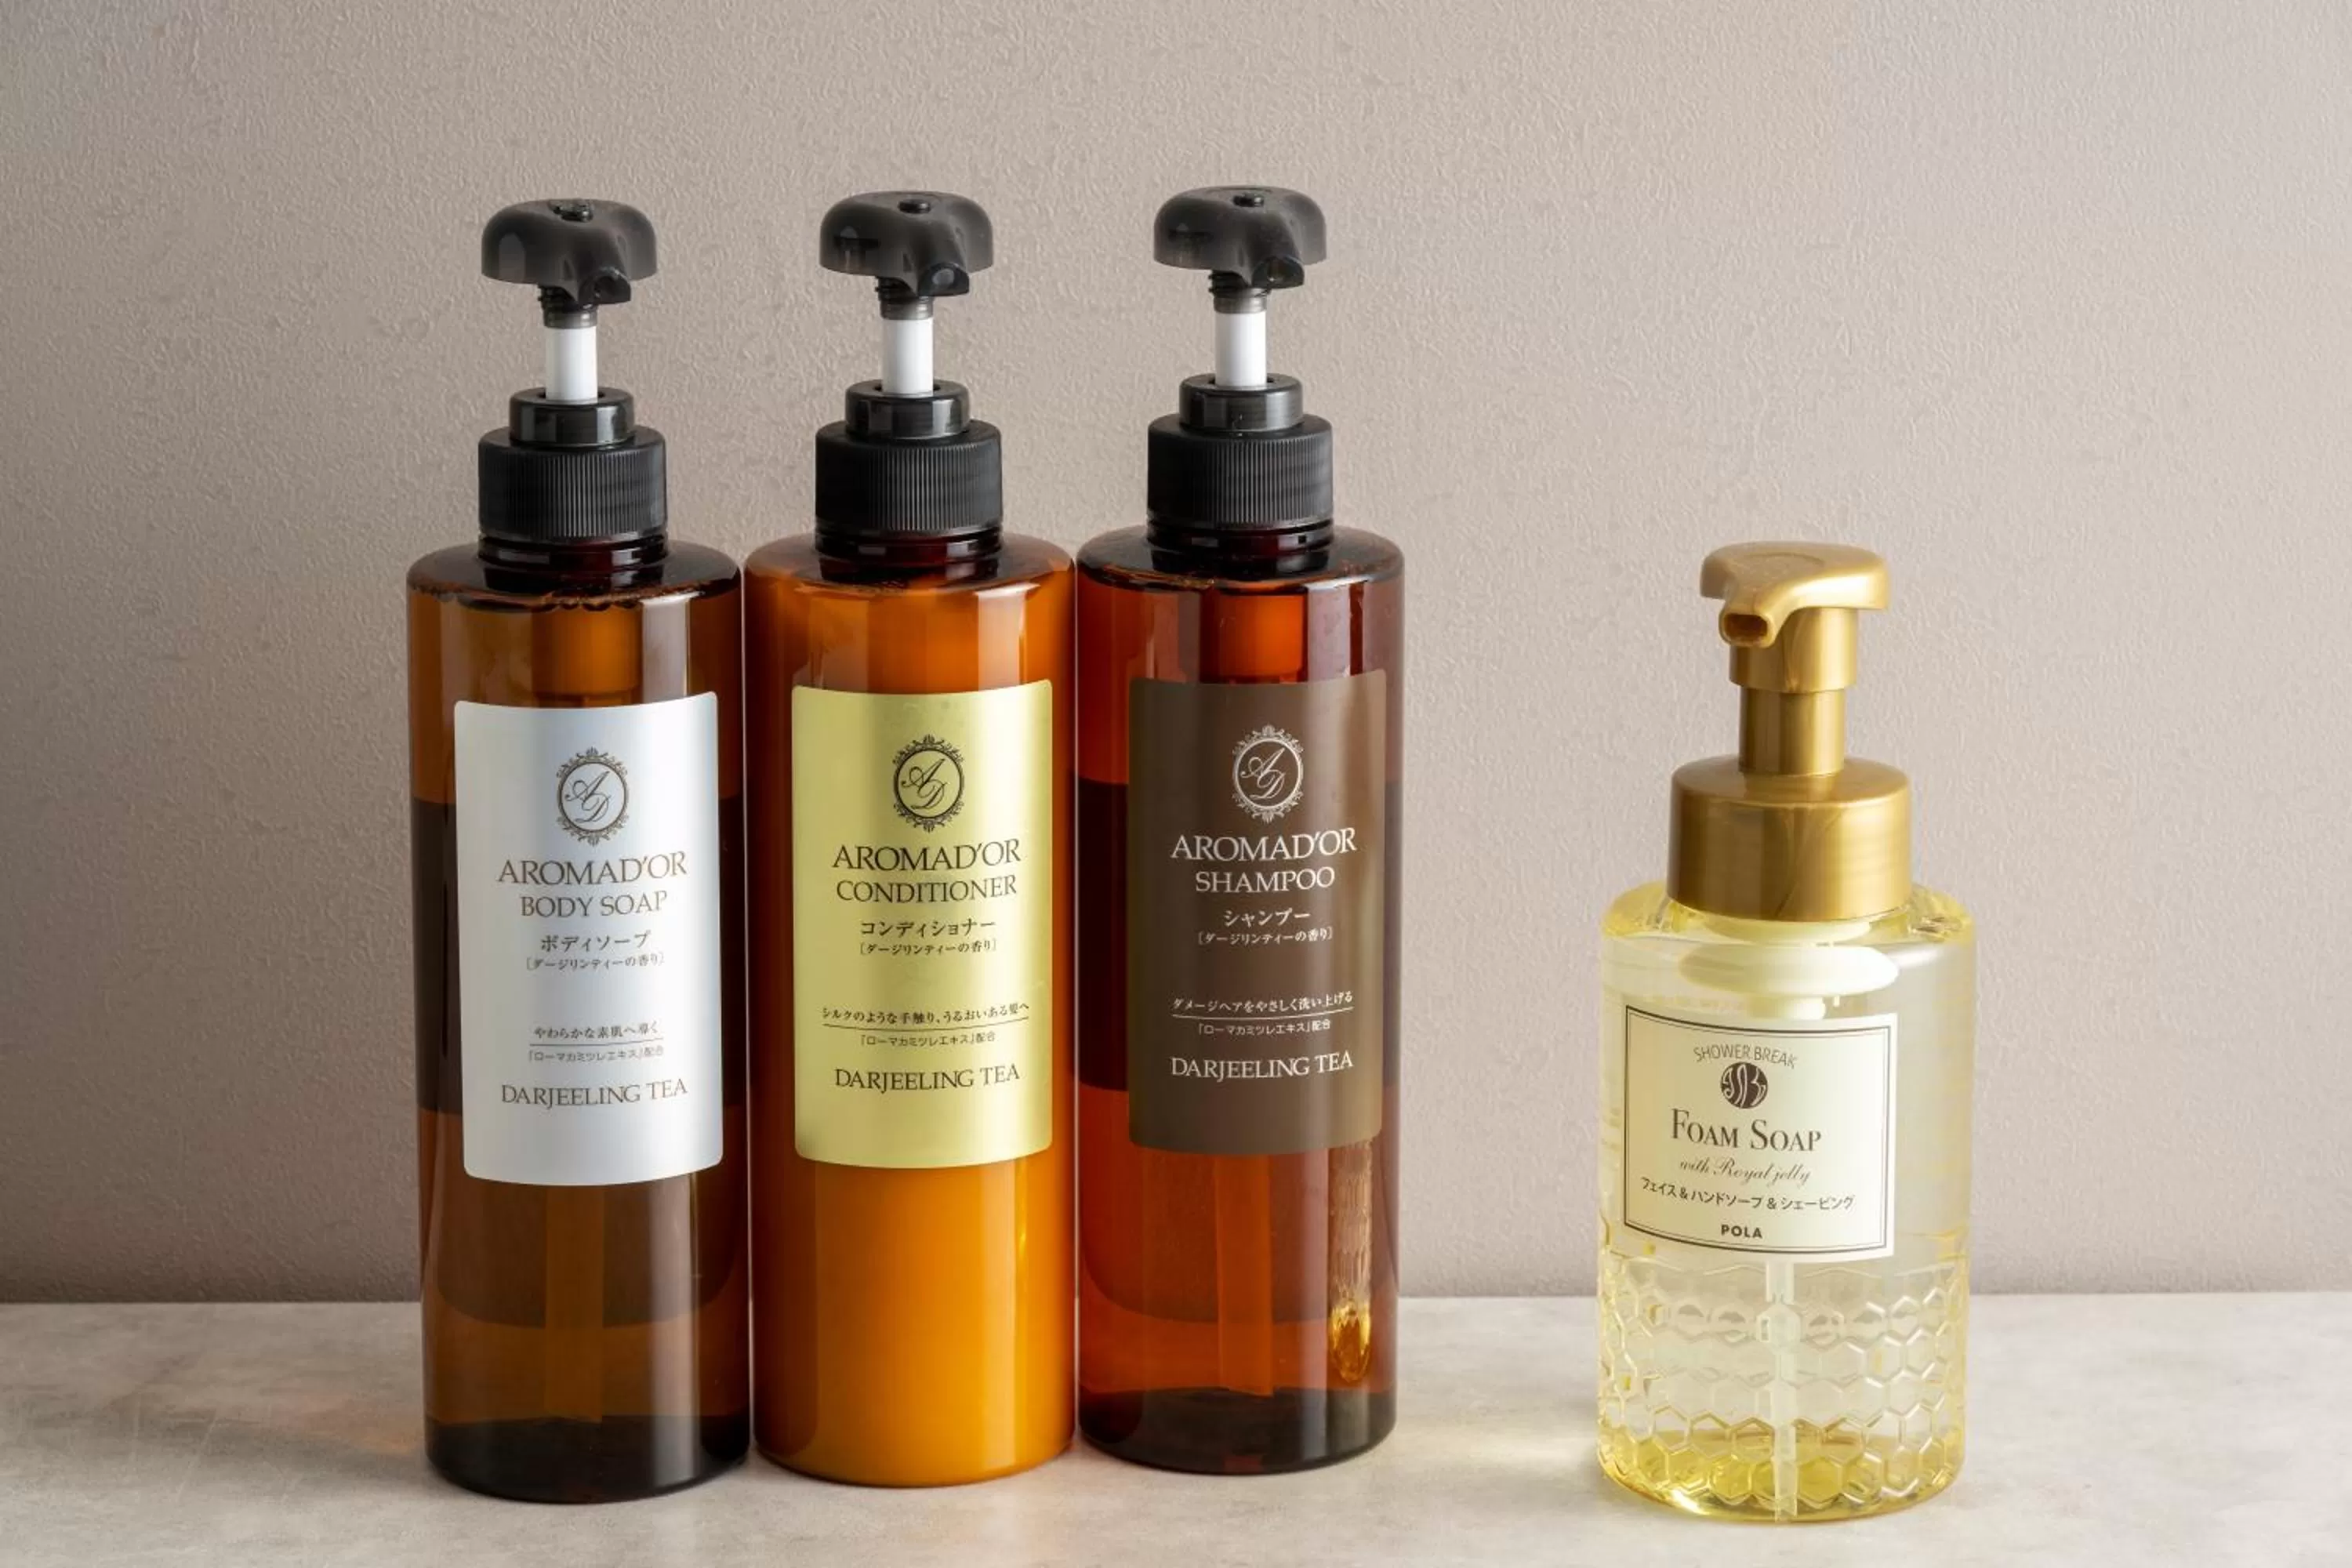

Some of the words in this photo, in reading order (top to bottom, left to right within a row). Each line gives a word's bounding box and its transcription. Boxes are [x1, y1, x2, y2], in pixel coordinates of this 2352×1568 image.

[832, 838, 1021, 872] AROMAD'OR
[1170, 826, 1357, 862] AROMAD'OR
[497, 851, 688, 885] AROMAD'OR
[1196, 866, 1335, 893] SHAMPOO
[836, 874, 1018, 903] CONDITIONER
[520, 896, 592, 918] BODY
[601, 890, 668, 916] SOAP
[1223, 907, 1312, 927] シャンプー
[540, 929, 652, 952] ボディソープ
[860, 917, 996, 938] コンディショナー
[1173, 990, 1354, 1014] ダメージヘアをやさしく洗い上げる
[534, 1021, 659, 1040] やわらかな素肌へ導く
[1171, 1056, 1310, 1083] DARJEELING
[1314, 1050, 1354, 1074] TEA
[1693, 1044, 1751, 1063] SHOWER
[1753, 1044, 1799, 1069] BREAK
[835, 1067, 975, 1094] DARJEELING
[980, 1062, 1022, 1086] TEA
[501, 1083, 641, 1110] DARJEELING
[646, 1078, 688, 1099] TEA
[1679, 1156, 1712, 1174] with
[1712, 1157, 1773, 1185] Royal
[1771, 1163, 1813, 1189] jelly
[1720, 1224, 1763, 1239] POLA
